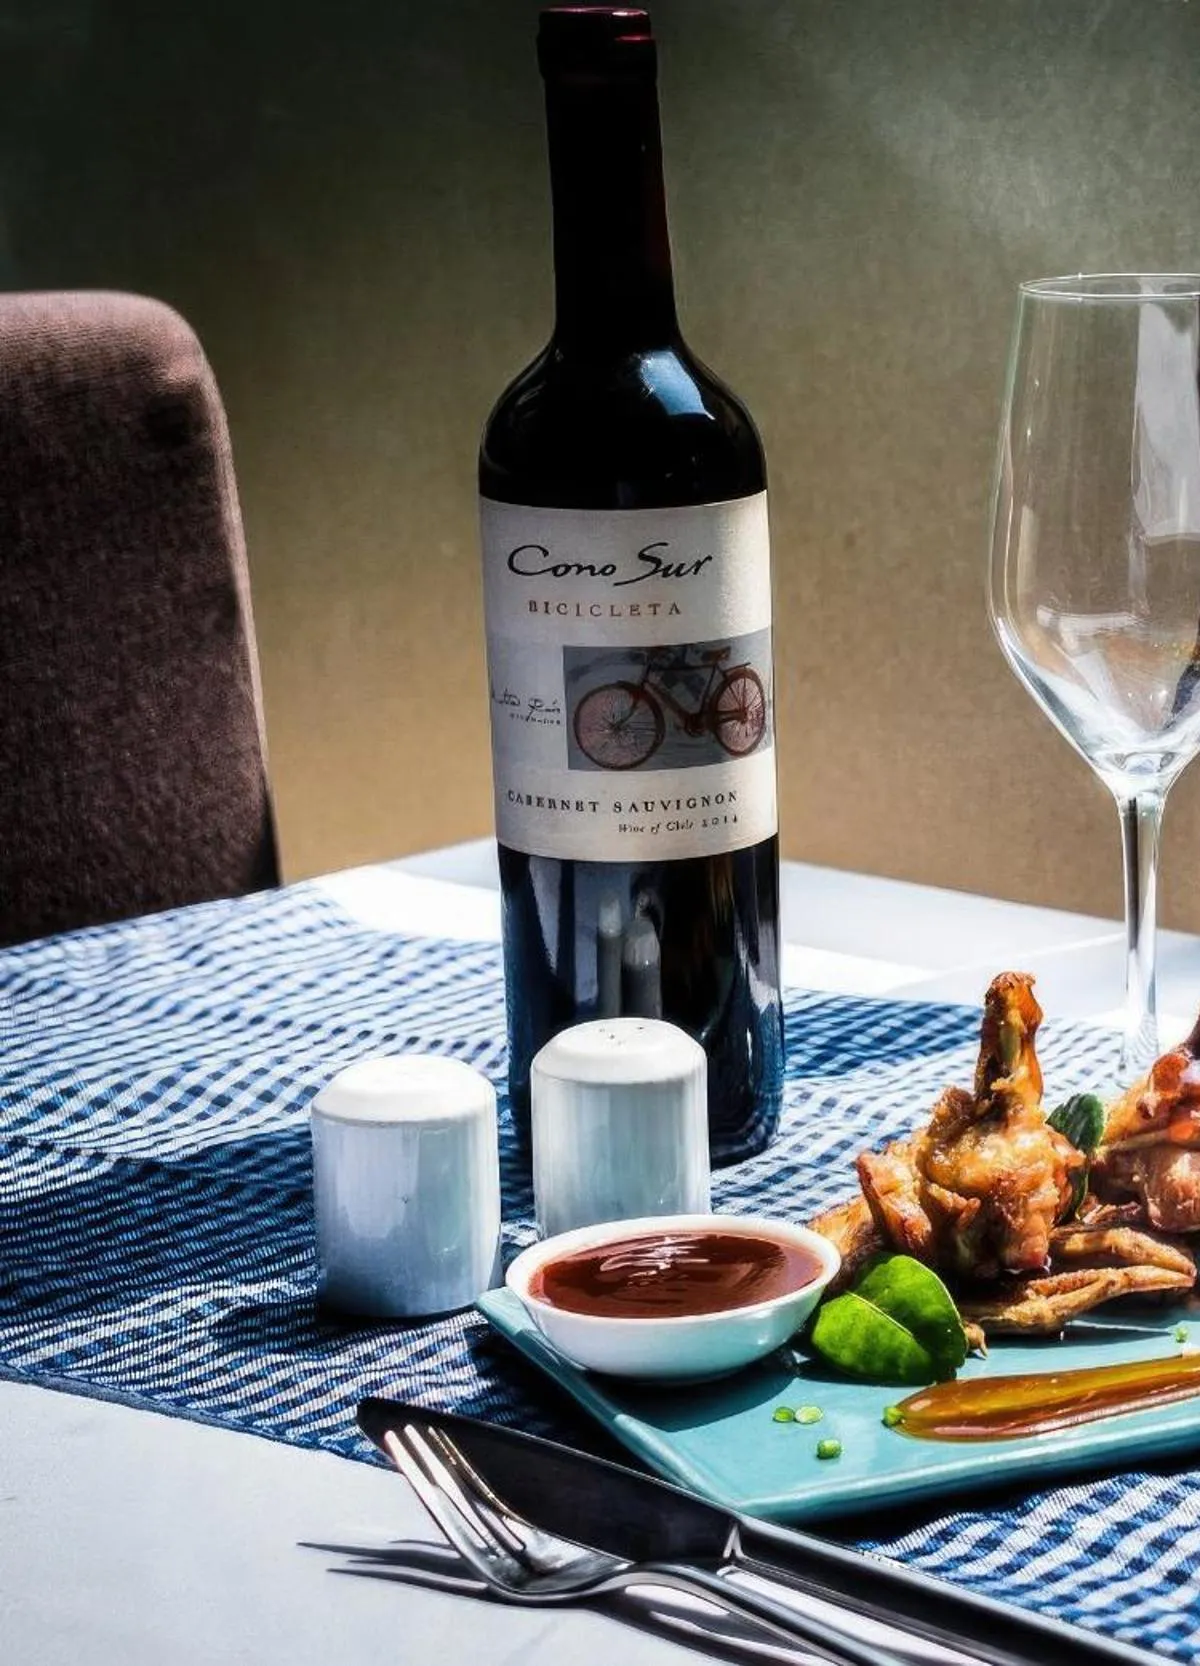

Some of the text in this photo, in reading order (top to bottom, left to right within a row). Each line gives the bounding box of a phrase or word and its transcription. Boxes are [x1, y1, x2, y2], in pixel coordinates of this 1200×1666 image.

[507, 542, 713, 586] Cono Sur
[528, 600, 682, 617] BICICLETA
[507, 789, 738, 813] CABERNET SAUVIGNON
